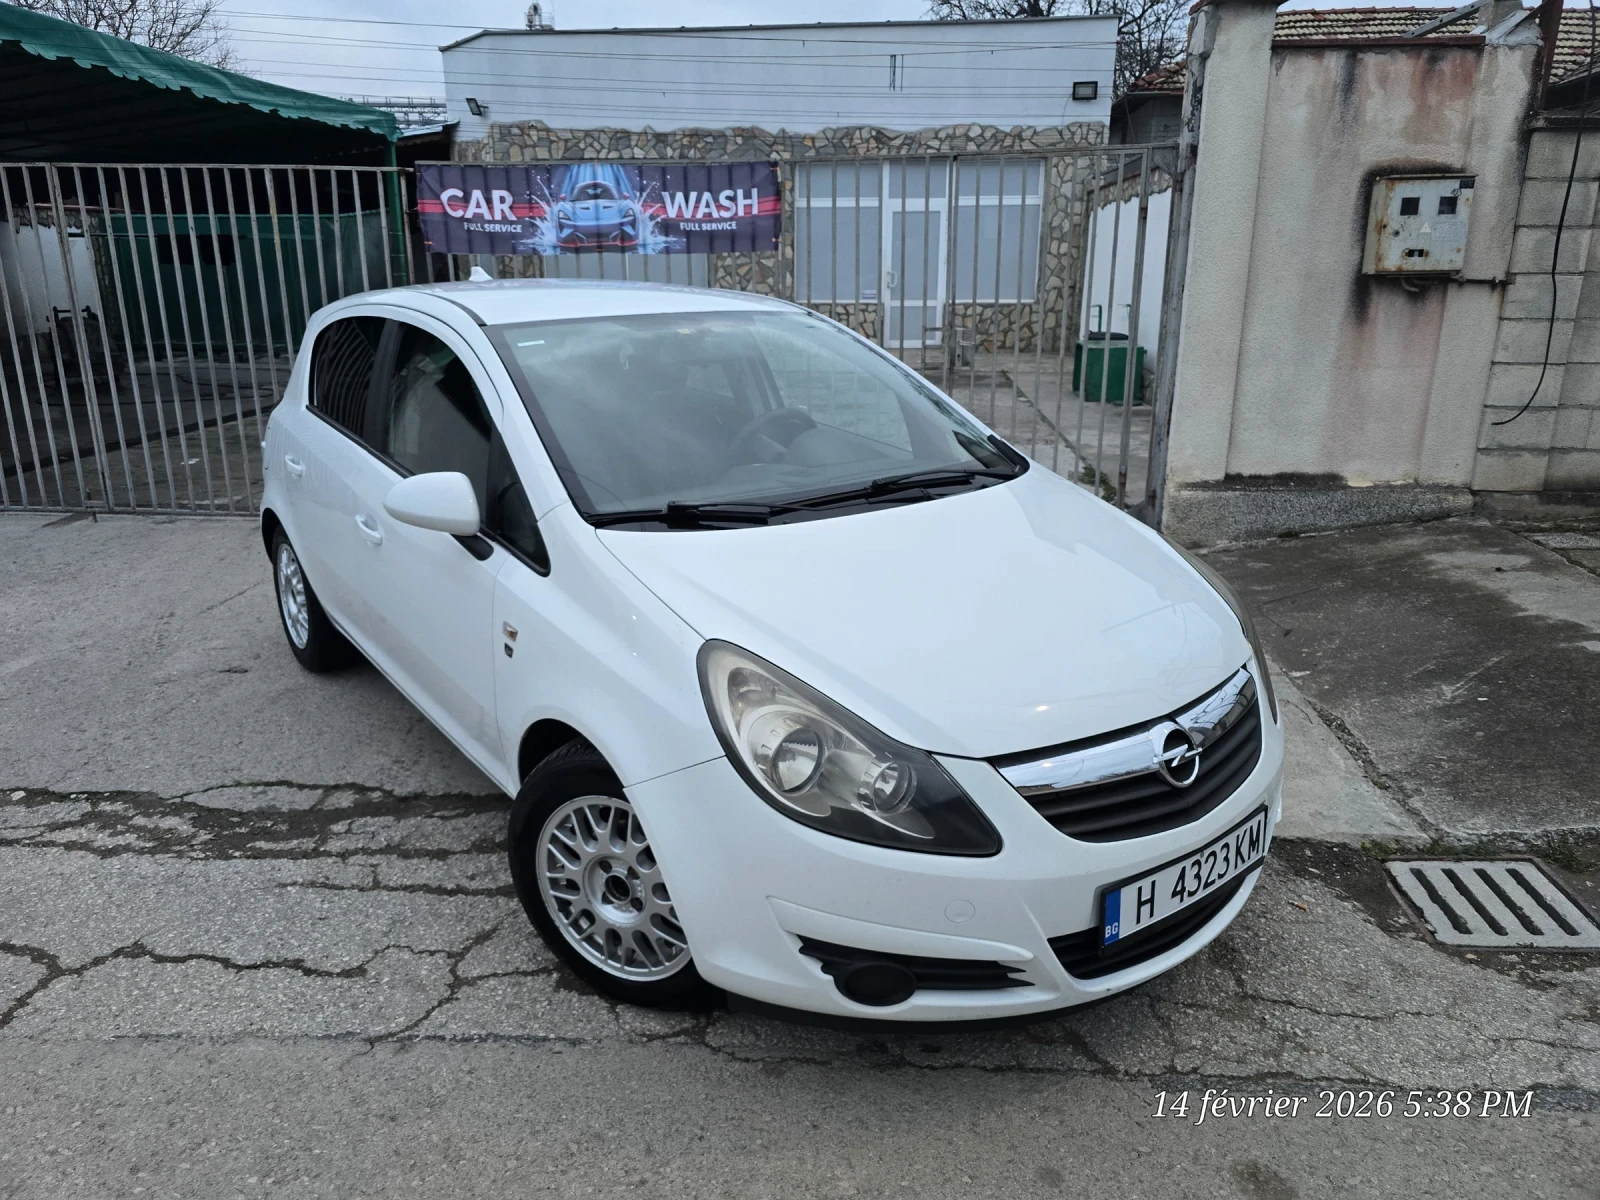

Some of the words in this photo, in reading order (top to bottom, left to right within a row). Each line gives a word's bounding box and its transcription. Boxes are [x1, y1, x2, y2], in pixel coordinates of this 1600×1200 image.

[440, 188, 517, 221] CAR
[661, 187, 759, 219] WASH
[463, 222, 484, 232] FULL
[484, 223, 523, 233] SERVICE
[680, 222, 700, 231] FULL
[701, 221, 737, 231] SERVICE
[1135, 879, 1156, 925] H
[1170, 842, 1231, 904] 4323
[1234, 818, 1262, 871] KM
[1105, 922, 1119, 939] BG
